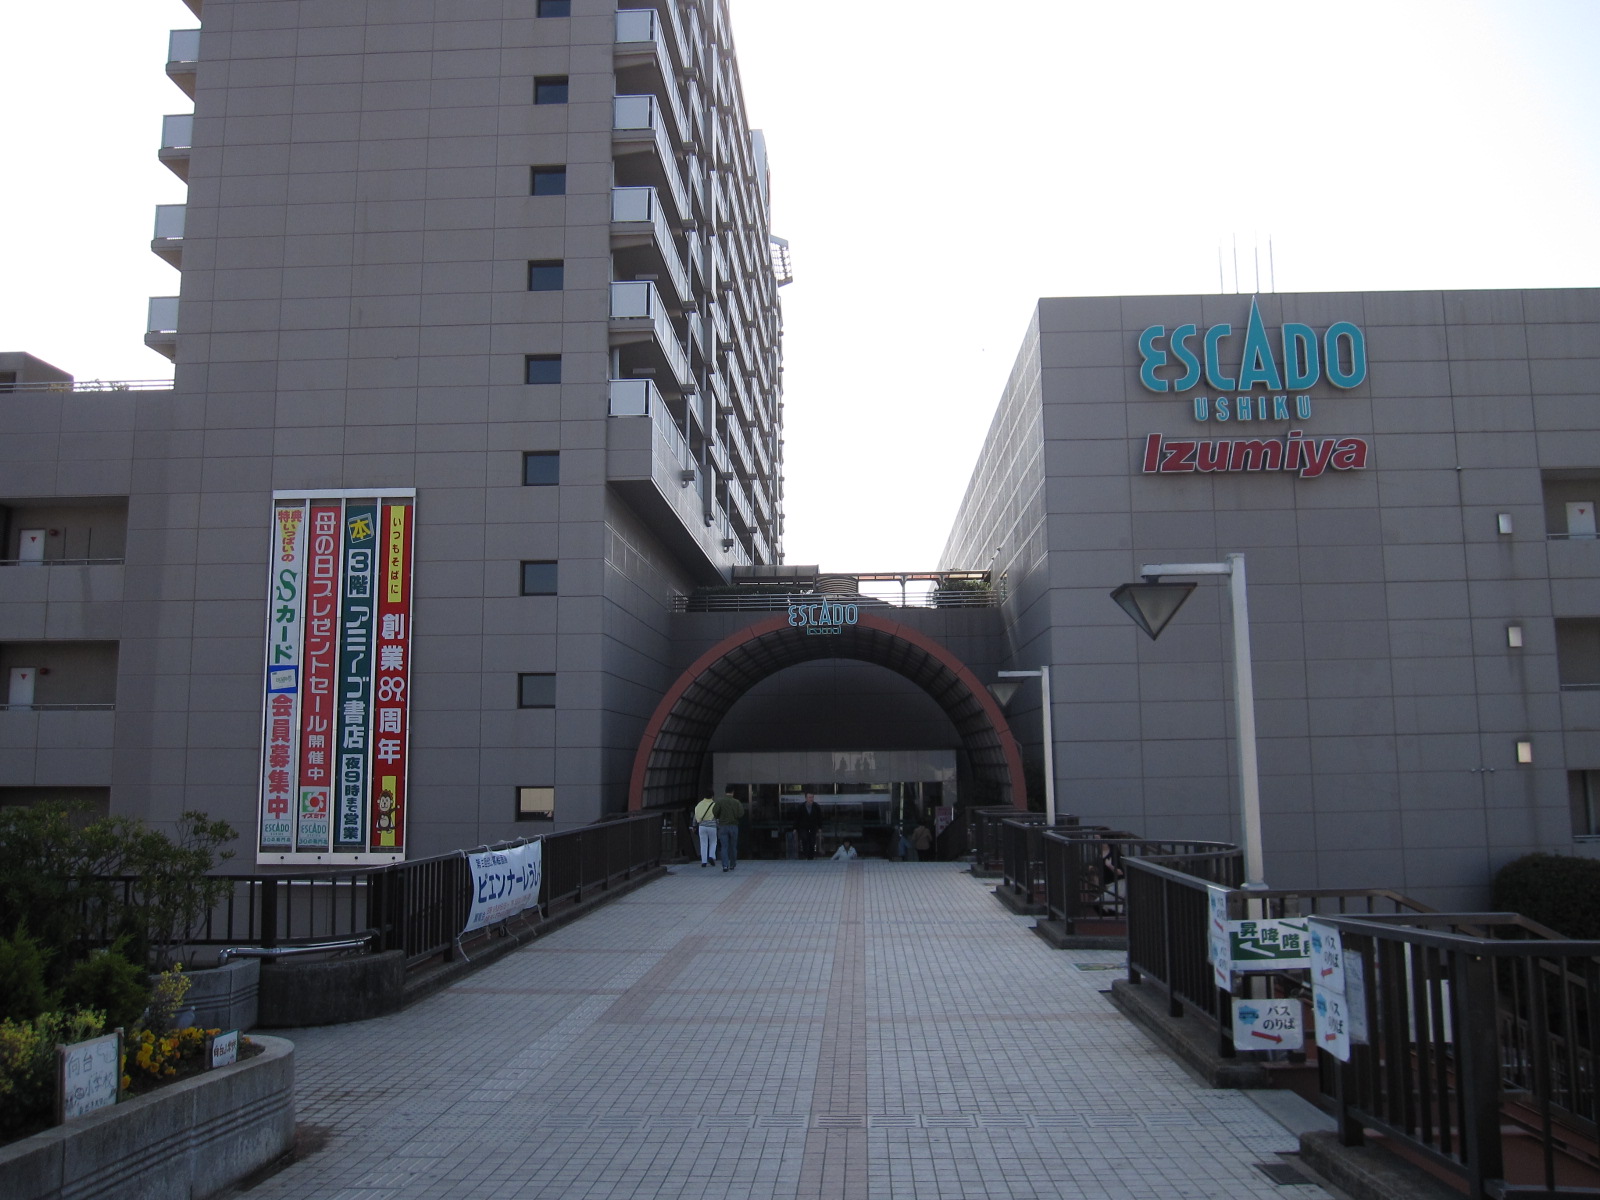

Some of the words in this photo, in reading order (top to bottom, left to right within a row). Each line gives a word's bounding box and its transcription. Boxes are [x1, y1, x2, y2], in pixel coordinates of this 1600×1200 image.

[1138, 294, 1368, 394] ESCADO
[1193, 395, 1313, 421] USHIKU
[1143, 429, 1369, 478] Izumiya
[349, 518, 371, 540] 本
[349, 551, 370, 596] 3階
[390, 516, 402, 595] いつもそばに
[275, 568, 298, 664] Sカード
[787, 596, 859, 626] ESCADO
[343, 604, 370, 750] アミーゴ書店
[268, 694, 293, 820] 会員募集中
[343, 757, 361, 840] 夜9時まで営業
[264, 821, 290, 833] ESCADO
[301, 822, 328, 834] ESCADO
[1262, 1017, 1296, 1032] のりば
[1267, 1005, 1291, 1017] バス
